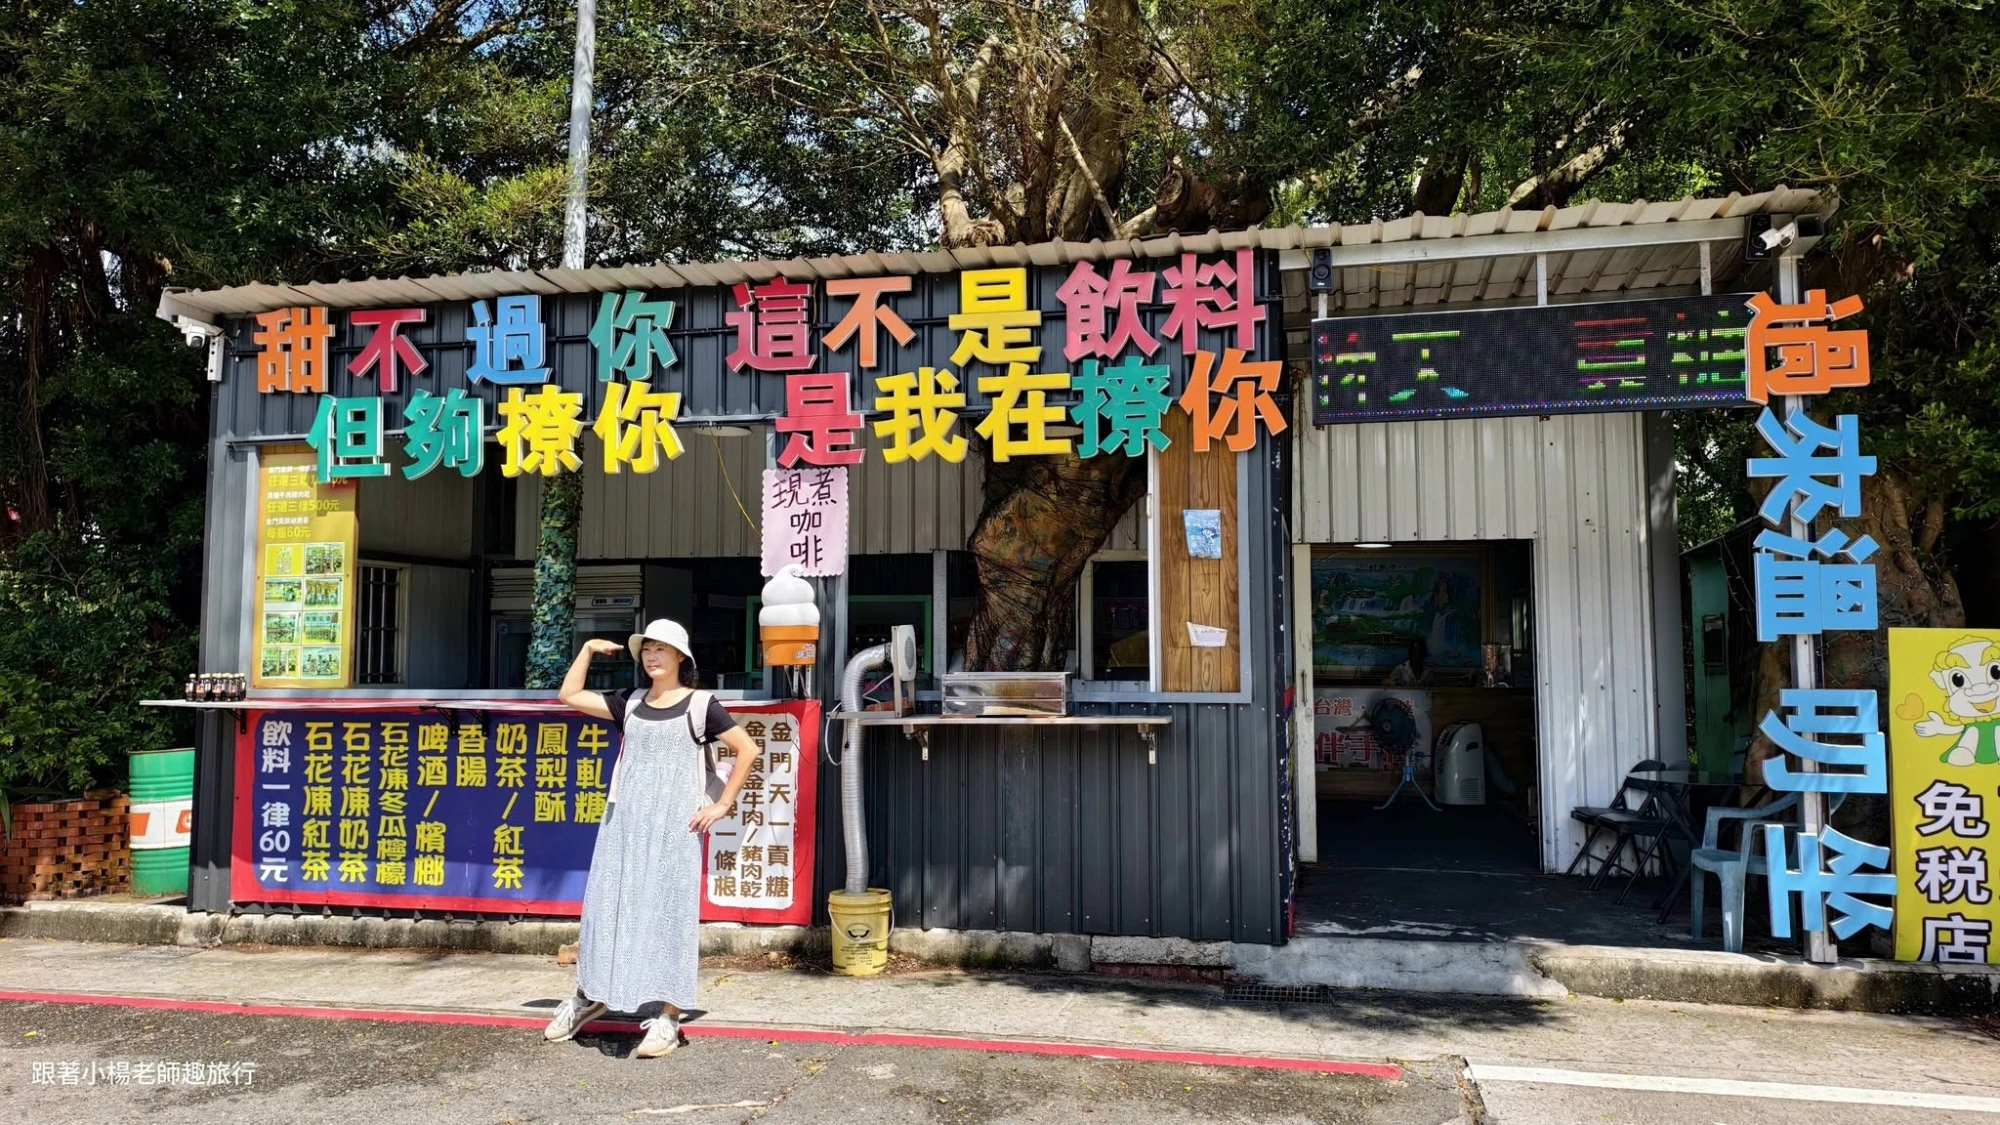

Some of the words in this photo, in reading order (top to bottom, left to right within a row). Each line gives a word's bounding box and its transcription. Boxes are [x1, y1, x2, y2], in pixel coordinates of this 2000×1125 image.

[306, 380, 685, 483] 但夠撩你
[774, 348, 1288, 468] 是我在撩你
[772, 469, 837, 509] 現煮
[790, 508, 824, 568] 咖啡
[259, 721, 292, 883] 飲料一律60元
[301, 721, 334, 881] 石花凍紅茶
[338, 721, 372, 883] 石花凍奶茶
[375, 721, 410, 886] 石花凍冬瓜檸檬
[456, 723, 488, 788] 香腸
[534, 722, 569, 823] 鳳梨酥
[574, 723, 609, 824] 牛軋糖
[765, 721, 793, 898] 金門天一貢糖
